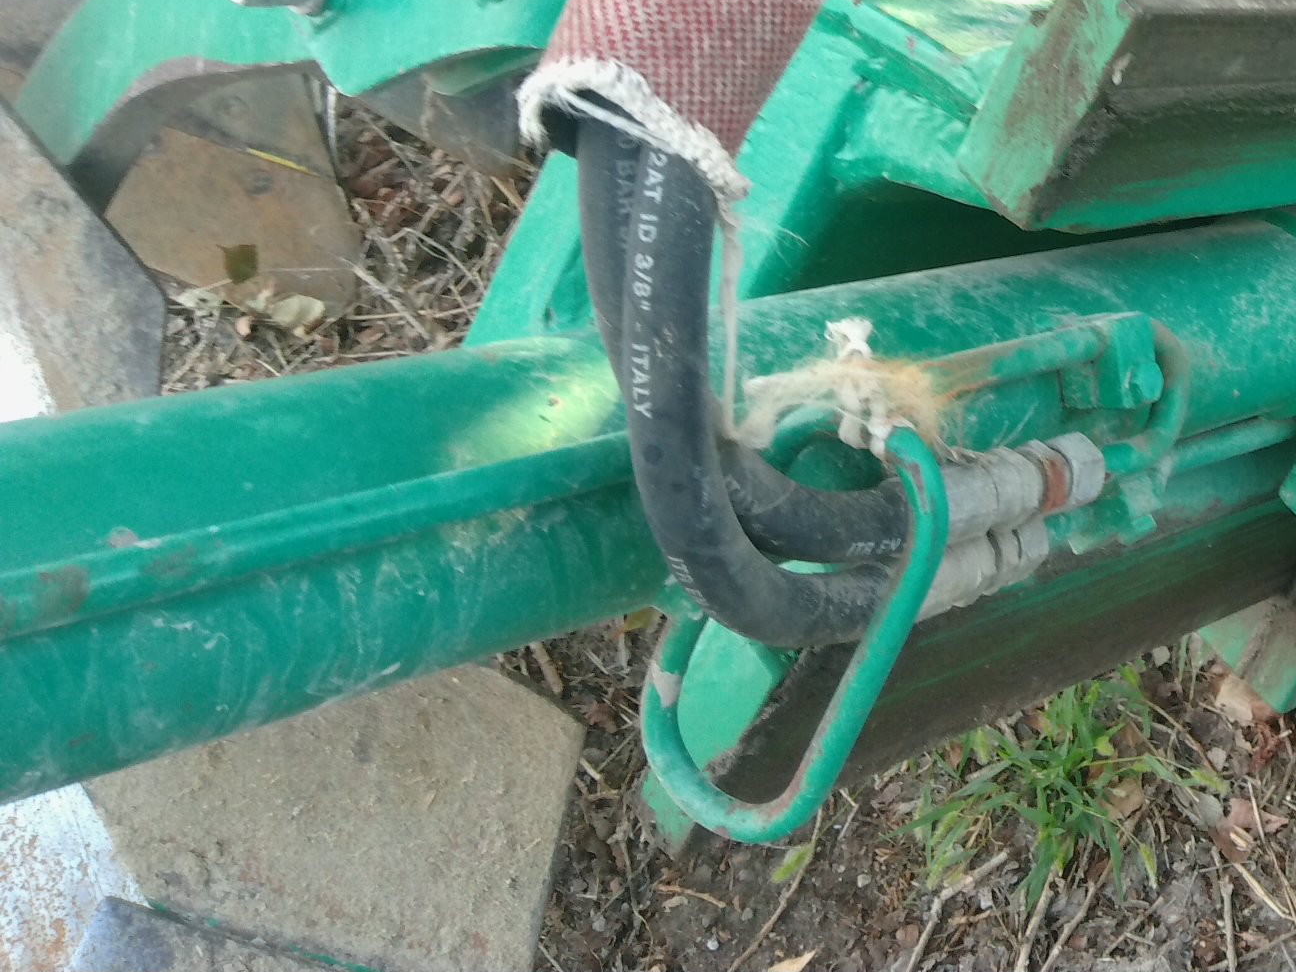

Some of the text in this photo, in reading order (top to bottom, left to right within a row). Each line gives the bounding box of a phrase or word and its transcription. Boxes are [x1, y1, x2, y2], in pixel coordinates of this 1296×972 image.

[638, 213, 659, 243] ID
[632, 252, 654, 311] 3/8"
[631, 342, 654, 419] ITALY
